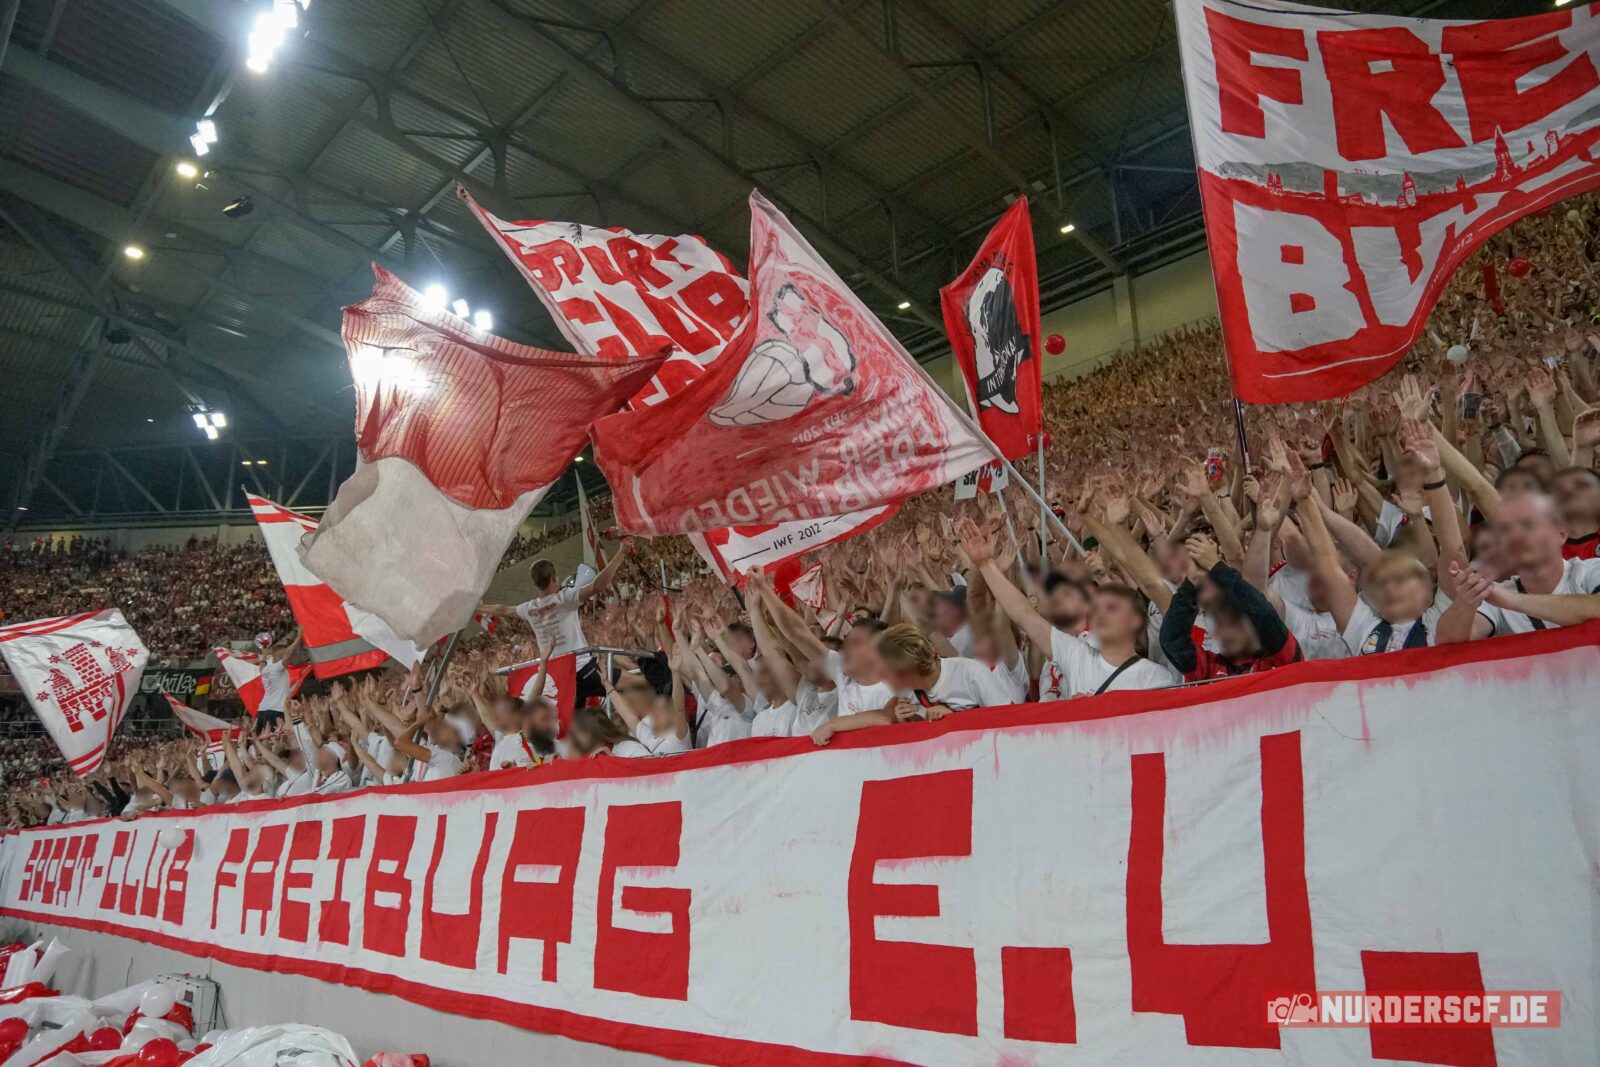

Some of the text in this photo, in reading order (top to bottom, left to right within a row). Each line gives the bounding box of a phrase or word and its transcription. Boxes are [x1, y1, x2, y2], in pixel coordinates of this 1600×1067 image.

[1203, 4, 1600, 162] FRE
[773, 533, 795, 551] IWF
[797, 522, 823, 541] 2012
[19, 829, 195, 926] SPORT-CLUB
[211, 801, 692, 1001] FREIBURG
